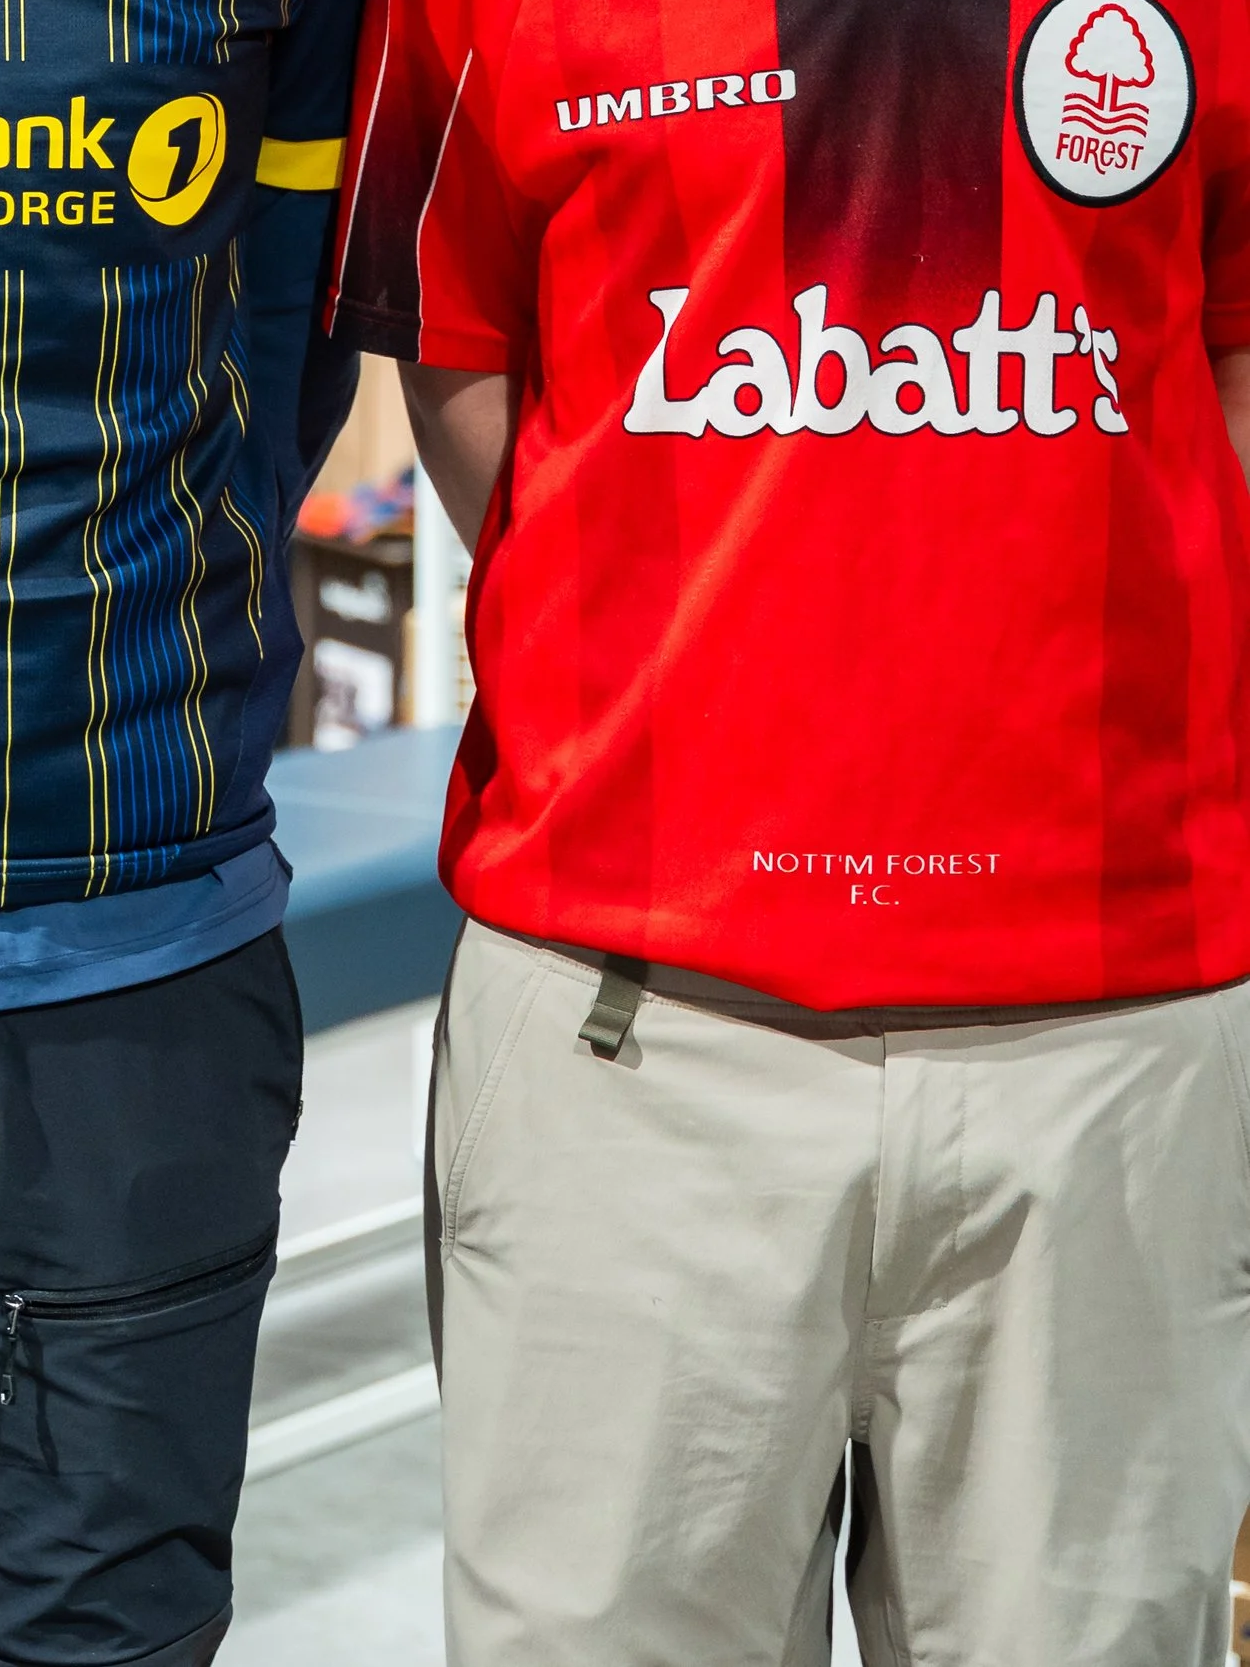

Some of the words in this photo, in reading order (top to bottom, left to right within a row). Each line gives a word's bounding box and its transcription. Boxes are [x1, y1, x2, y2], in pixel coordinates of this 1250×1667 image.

[554, 69, 797, 132] UMBRO
[623, 284, 1129, 437] Labatt's
[753, 851, 873, 875] NOTT'M
[888, 853, 1001, 875] FOREST
[850, 884, 900, 905] F.C.
